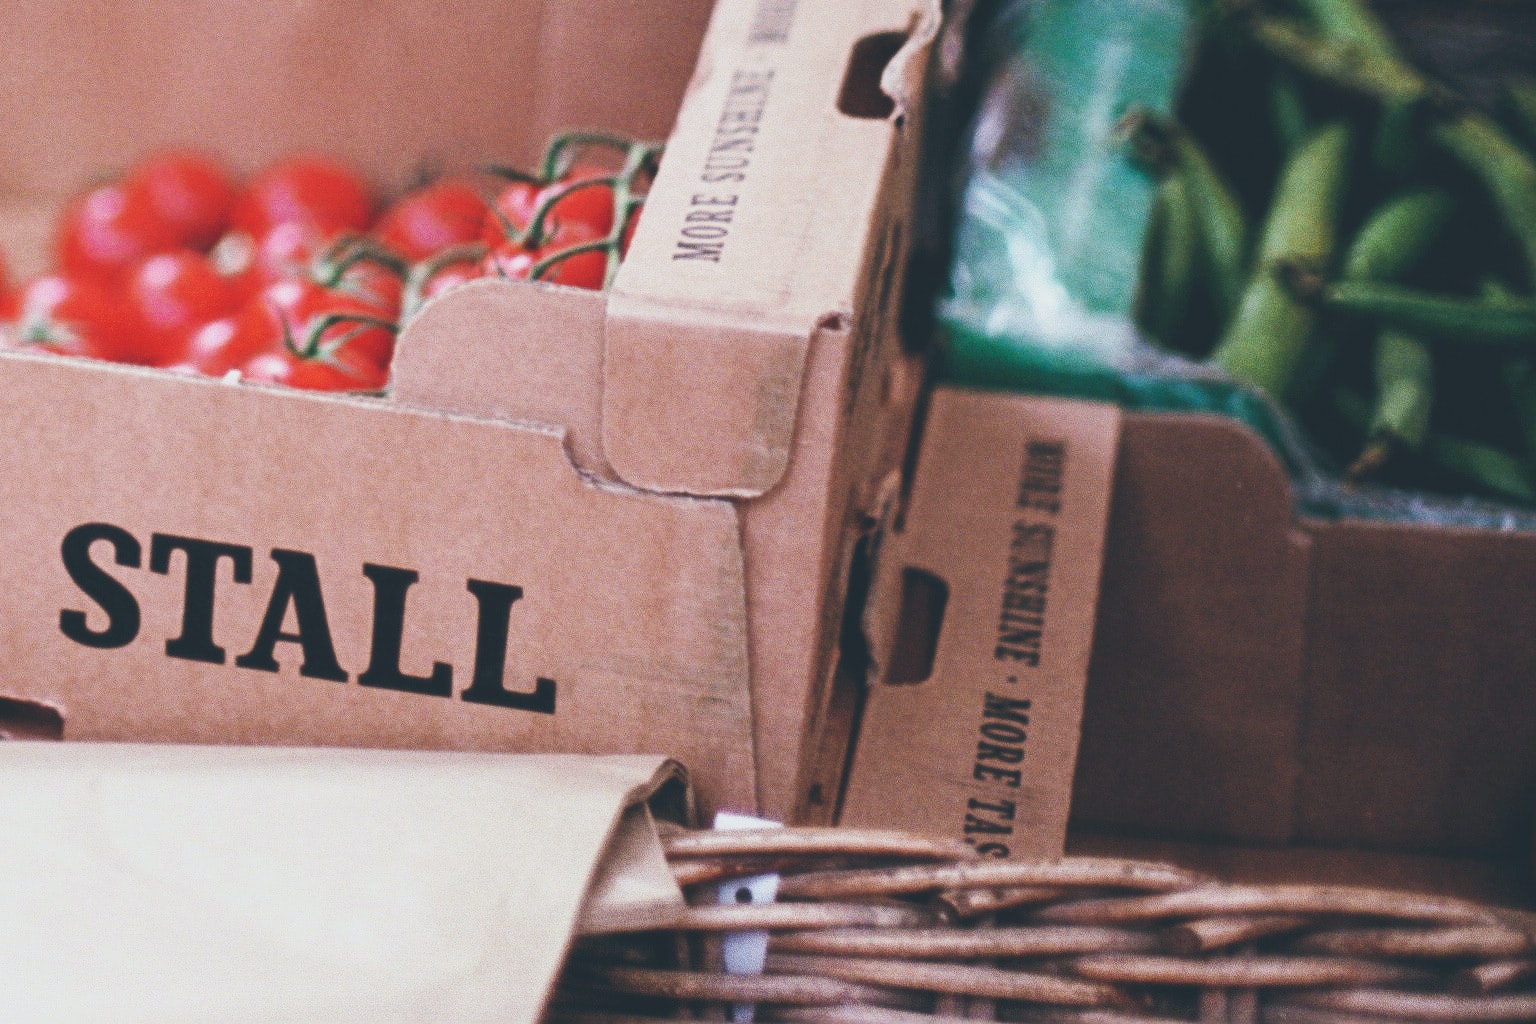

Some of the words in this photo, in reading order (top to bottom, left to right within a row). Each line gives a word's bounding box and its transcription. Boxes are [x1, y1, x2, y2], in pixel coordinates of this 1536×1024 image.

[672, 193, 739, 264] MORE
[59, 521, 557, 716] STALL
[972, 691, 1031, 788] MORE
